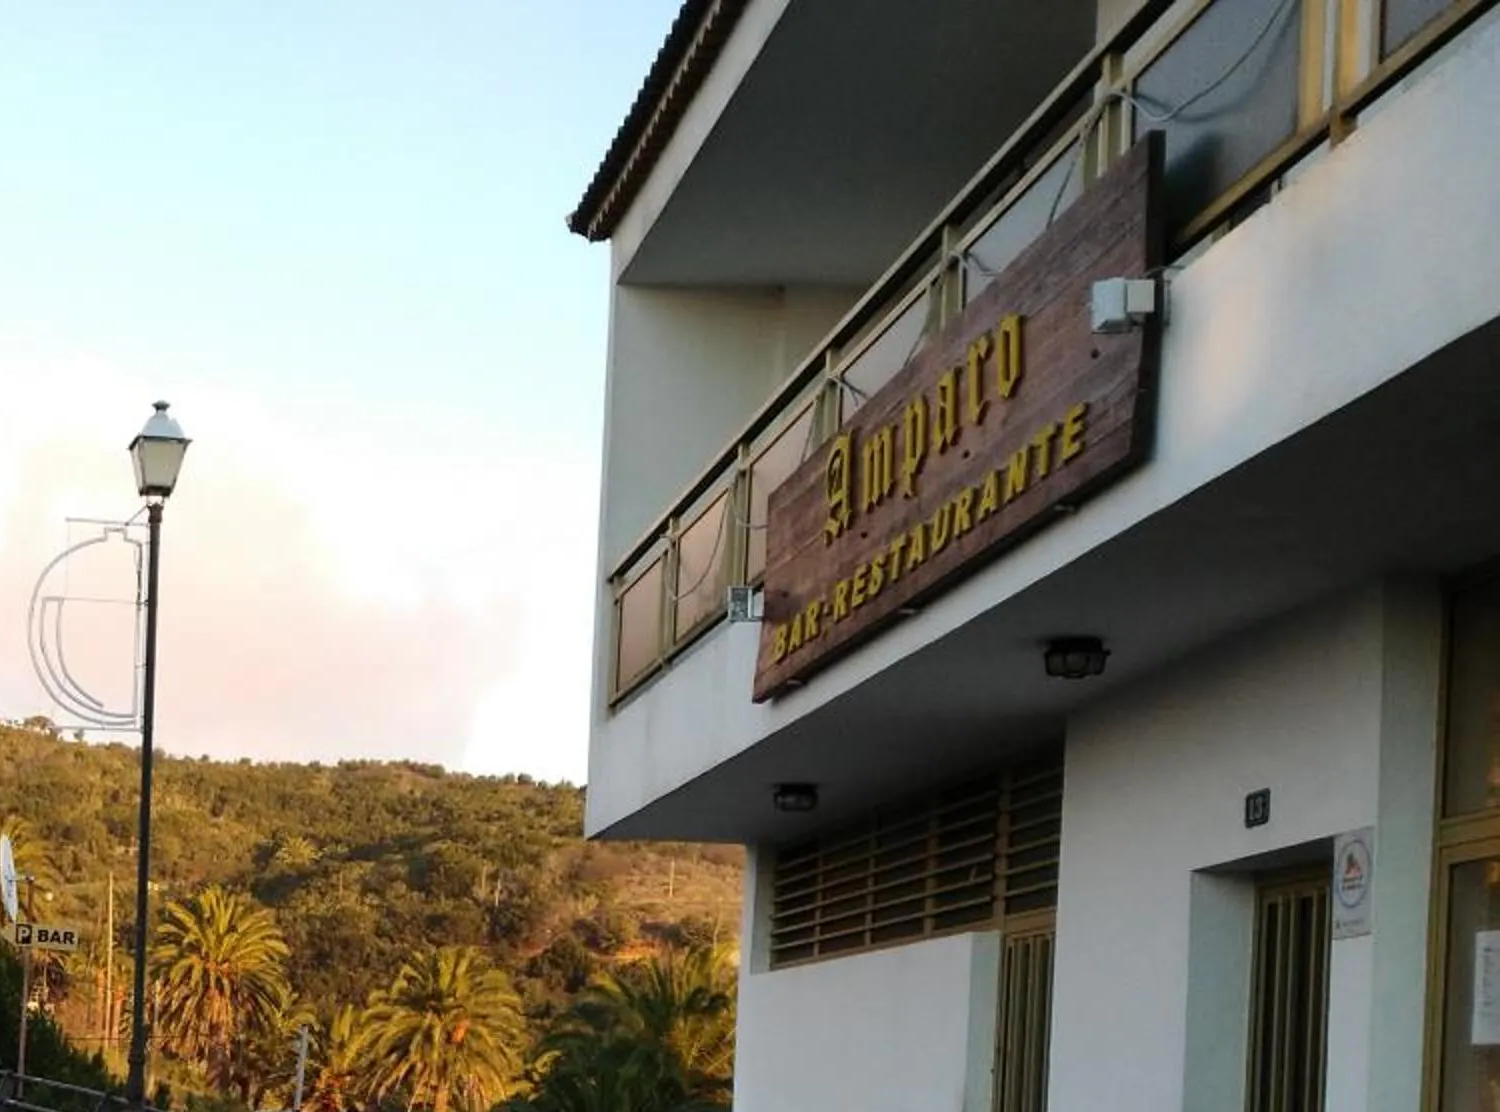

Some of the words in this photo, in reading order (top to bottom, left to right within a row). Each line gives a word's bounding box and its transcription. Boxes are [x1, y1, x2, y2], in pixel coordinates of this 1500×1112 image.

[824, 314, 1024, 543] Amparo
[18, 925, 31, 943] P
[37, 929, 75, 945] BAR
